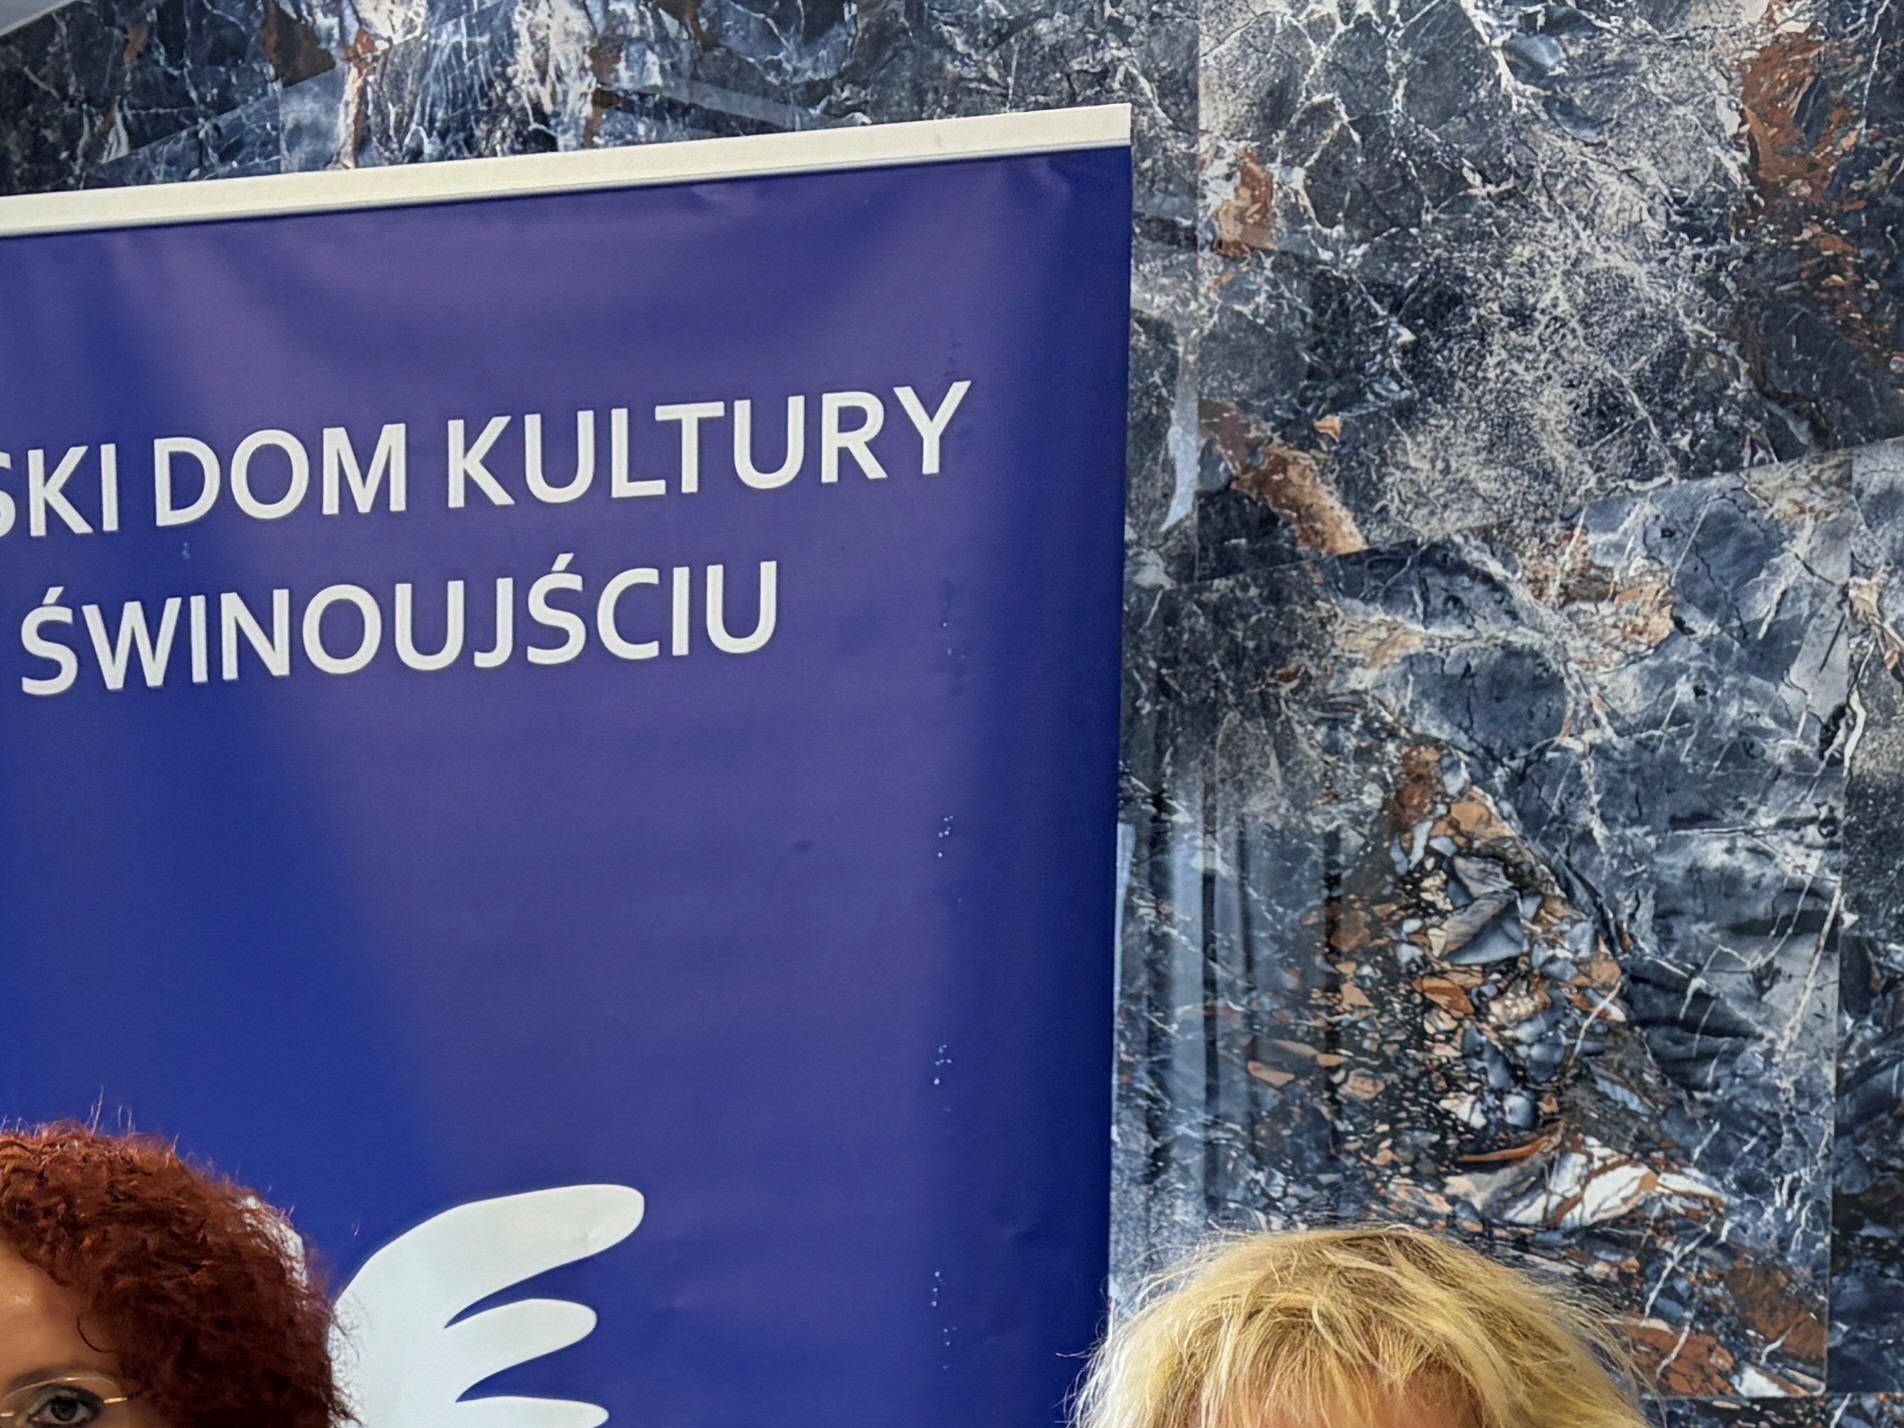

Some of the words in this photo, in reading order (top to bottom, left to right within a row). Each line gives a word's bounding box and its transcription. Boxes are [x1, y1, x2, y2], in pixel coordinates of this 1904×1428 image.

[153, 422, 407, 528] DOM
[446, 380, 972, 509] KULTURY
[21, 551, 778, 697] ŚWINOUJŚCIU
